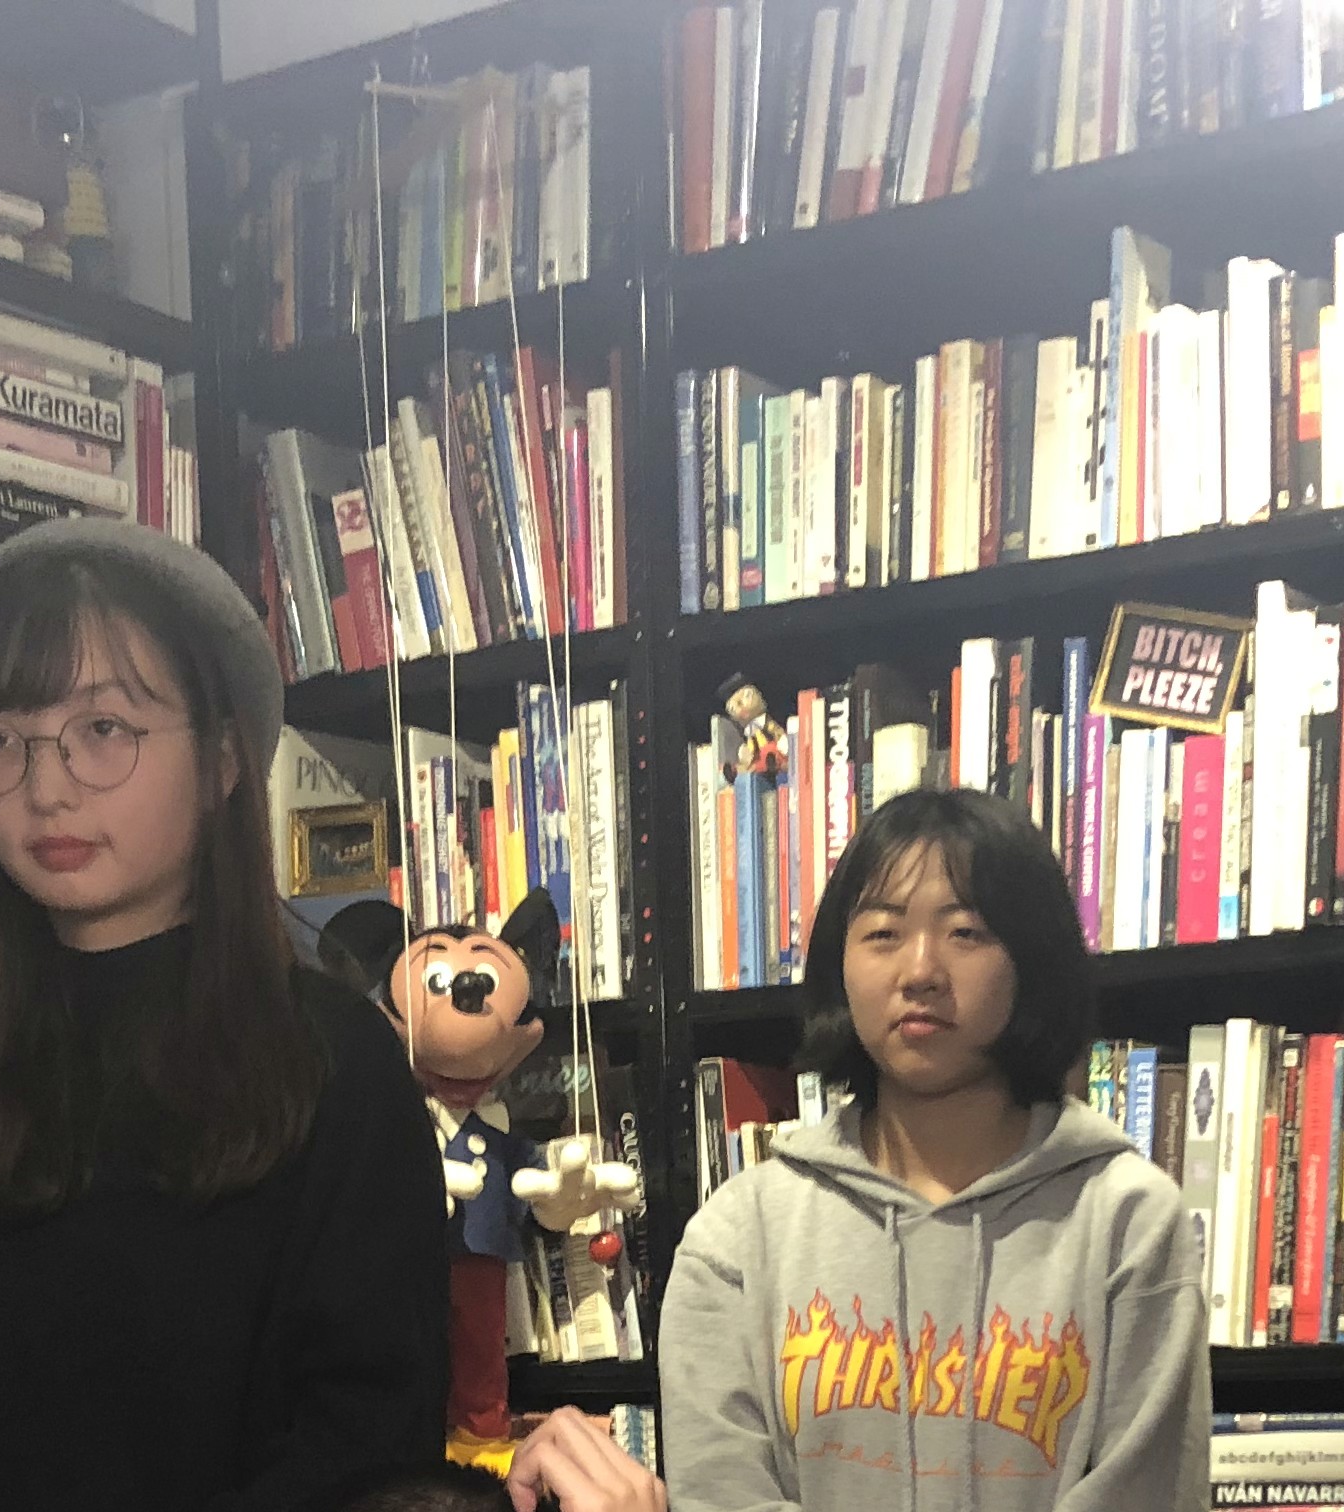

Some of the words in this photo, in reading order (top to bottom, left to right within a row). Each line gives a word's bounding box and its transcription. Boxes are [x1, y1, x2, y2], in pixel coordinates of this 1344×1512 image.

[1131, 625, 1225, 677] BITCH,
[1121, 664, 1219, 715] PLEEZE
[1189, 769, 1211, 883] cream
[1216, 1480, 1264, 1503] IVÁN
